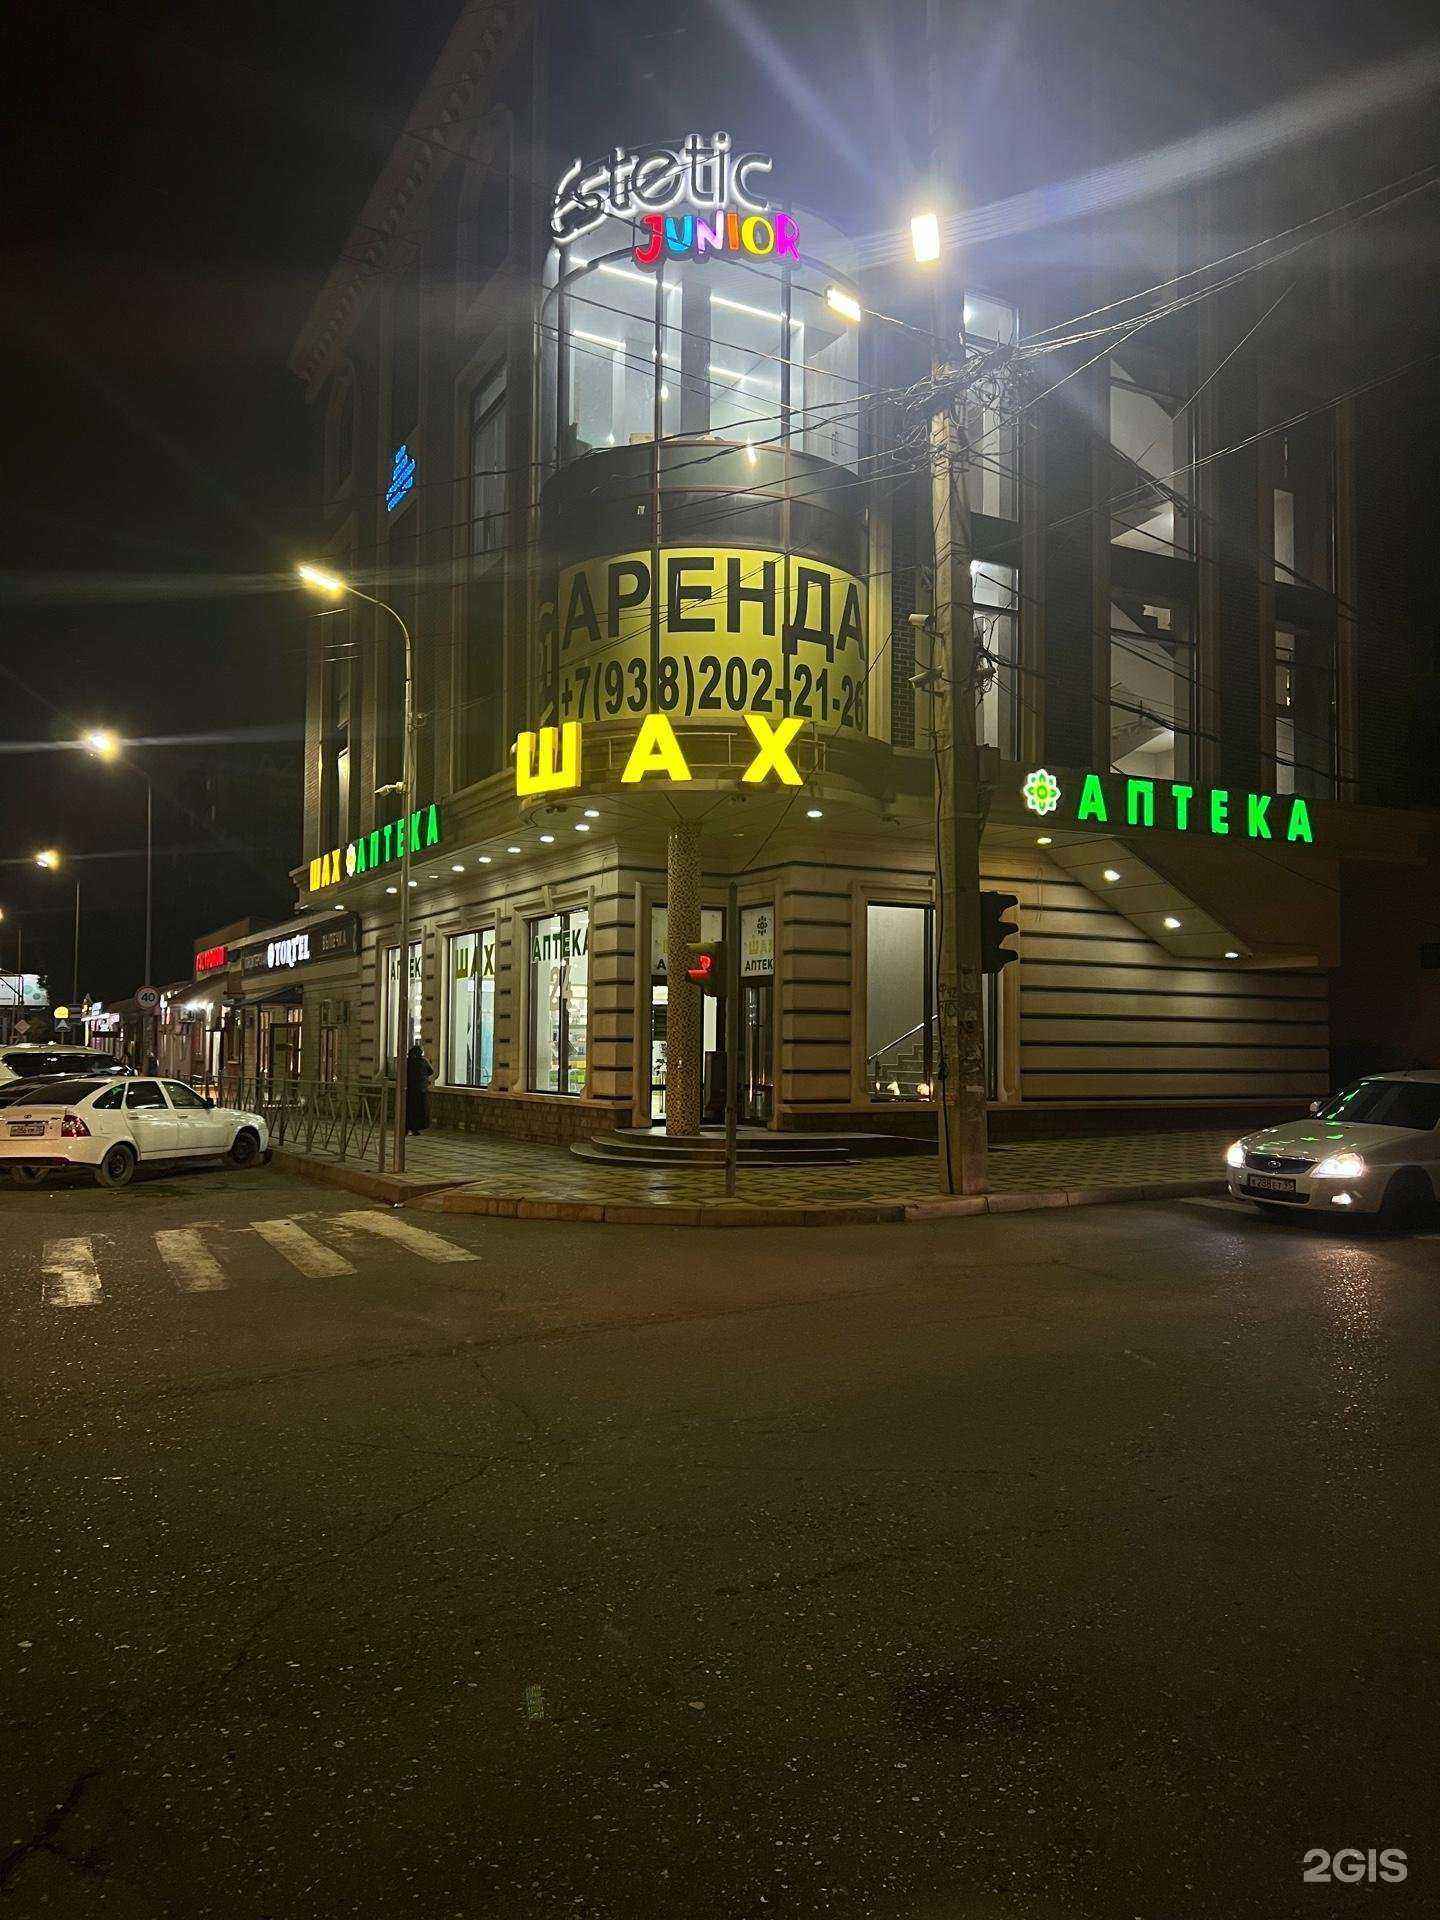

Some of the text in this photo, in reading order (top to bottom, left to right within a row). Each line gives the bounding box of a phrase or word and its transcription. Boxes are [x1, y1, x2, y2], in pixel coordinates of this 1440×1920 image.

[633, 209, 800, 264] JUNIOR
[561, 556, 866, 663] АРЕНДА
[516, 714, 804, 797] ШАХ
[1077, 774, 1314, 843] АПТЕКА
[309, 803, 439, 892] ШАХ АПТЕКА
[140, 992, 156, 1002] 40
[744, 958, 774, 972] АПТЕК
